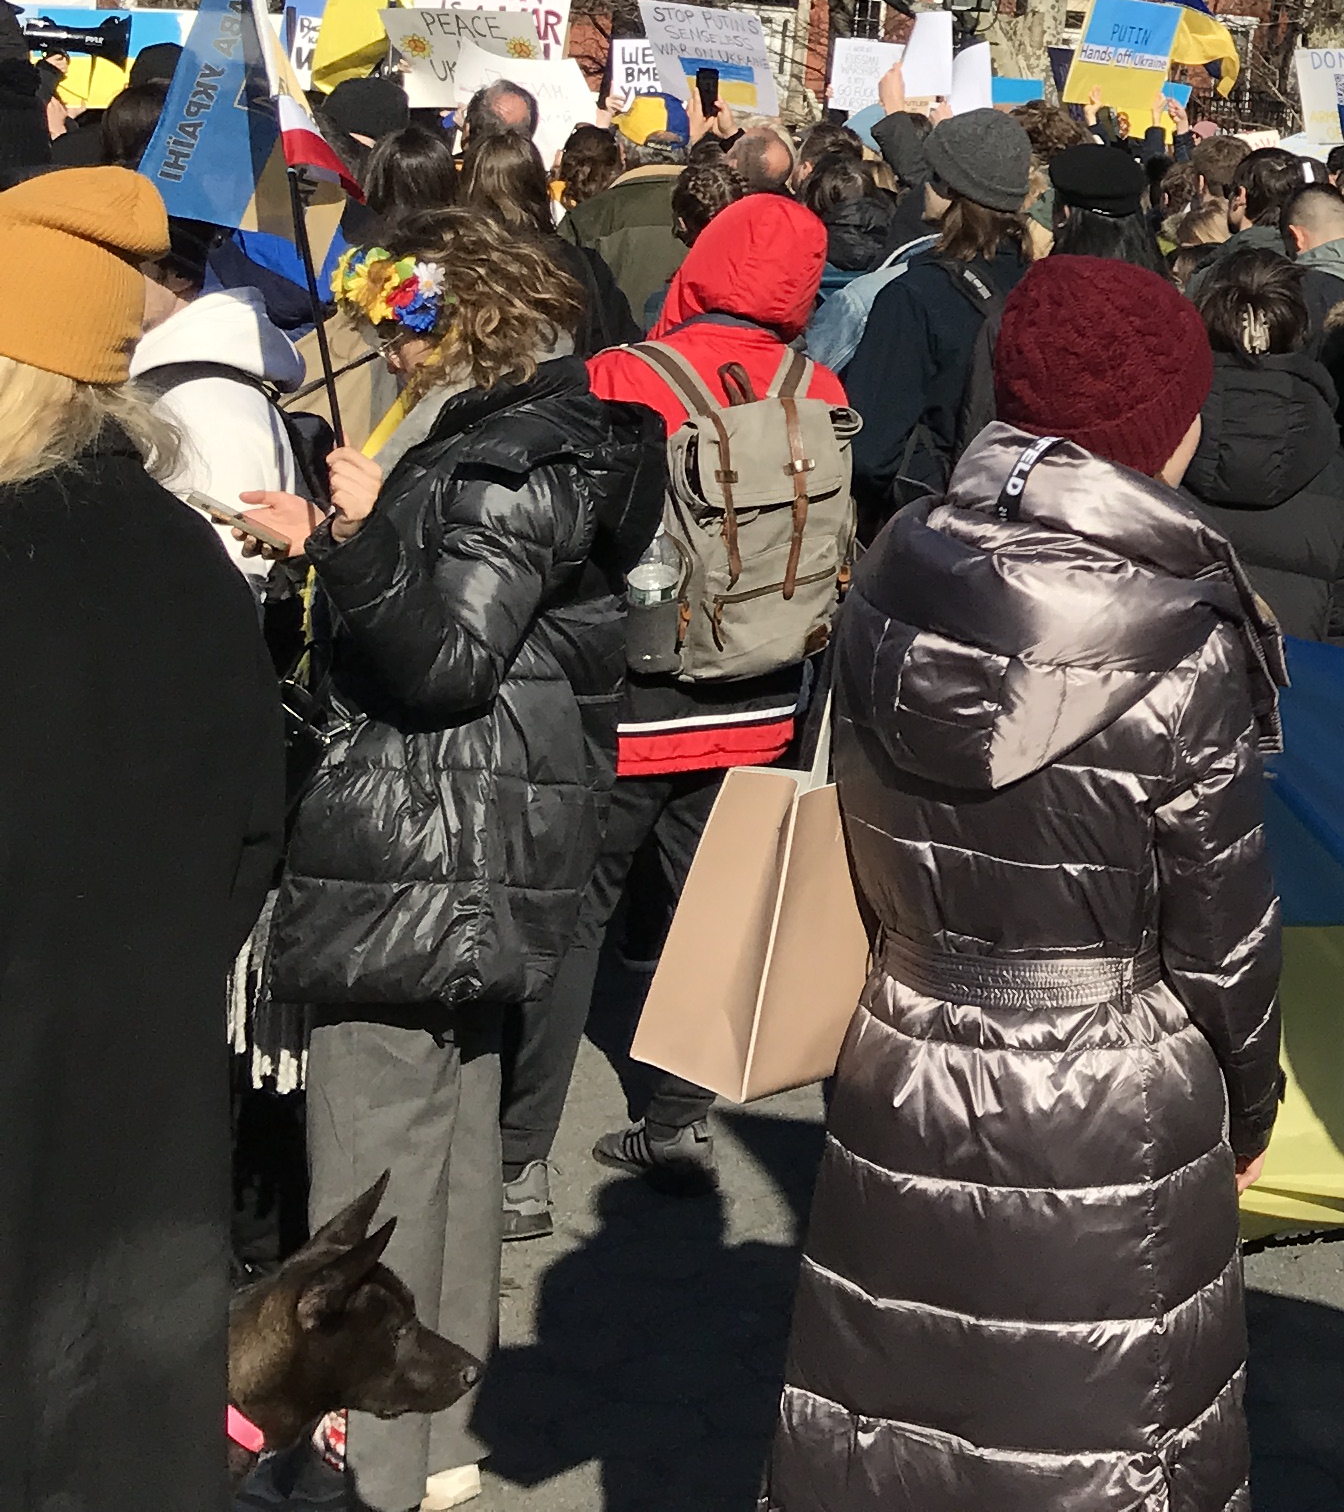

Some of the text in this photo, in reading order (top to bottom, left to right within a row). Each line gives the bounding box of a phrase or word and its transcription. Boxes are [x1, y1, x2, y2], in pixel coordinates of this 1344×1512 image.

[421, 11, 508, 41] PEACE
[653, 6, 695, 23] STOP
[664, 24, 754, 51] SENSELESS
[1110, 23, 1153, 46] PUTIN
[654, 41, 689, 56] WAR
[694, 46, 714, 59] ON
[1080, 45, 1168, 71] Hands off Ukraine
